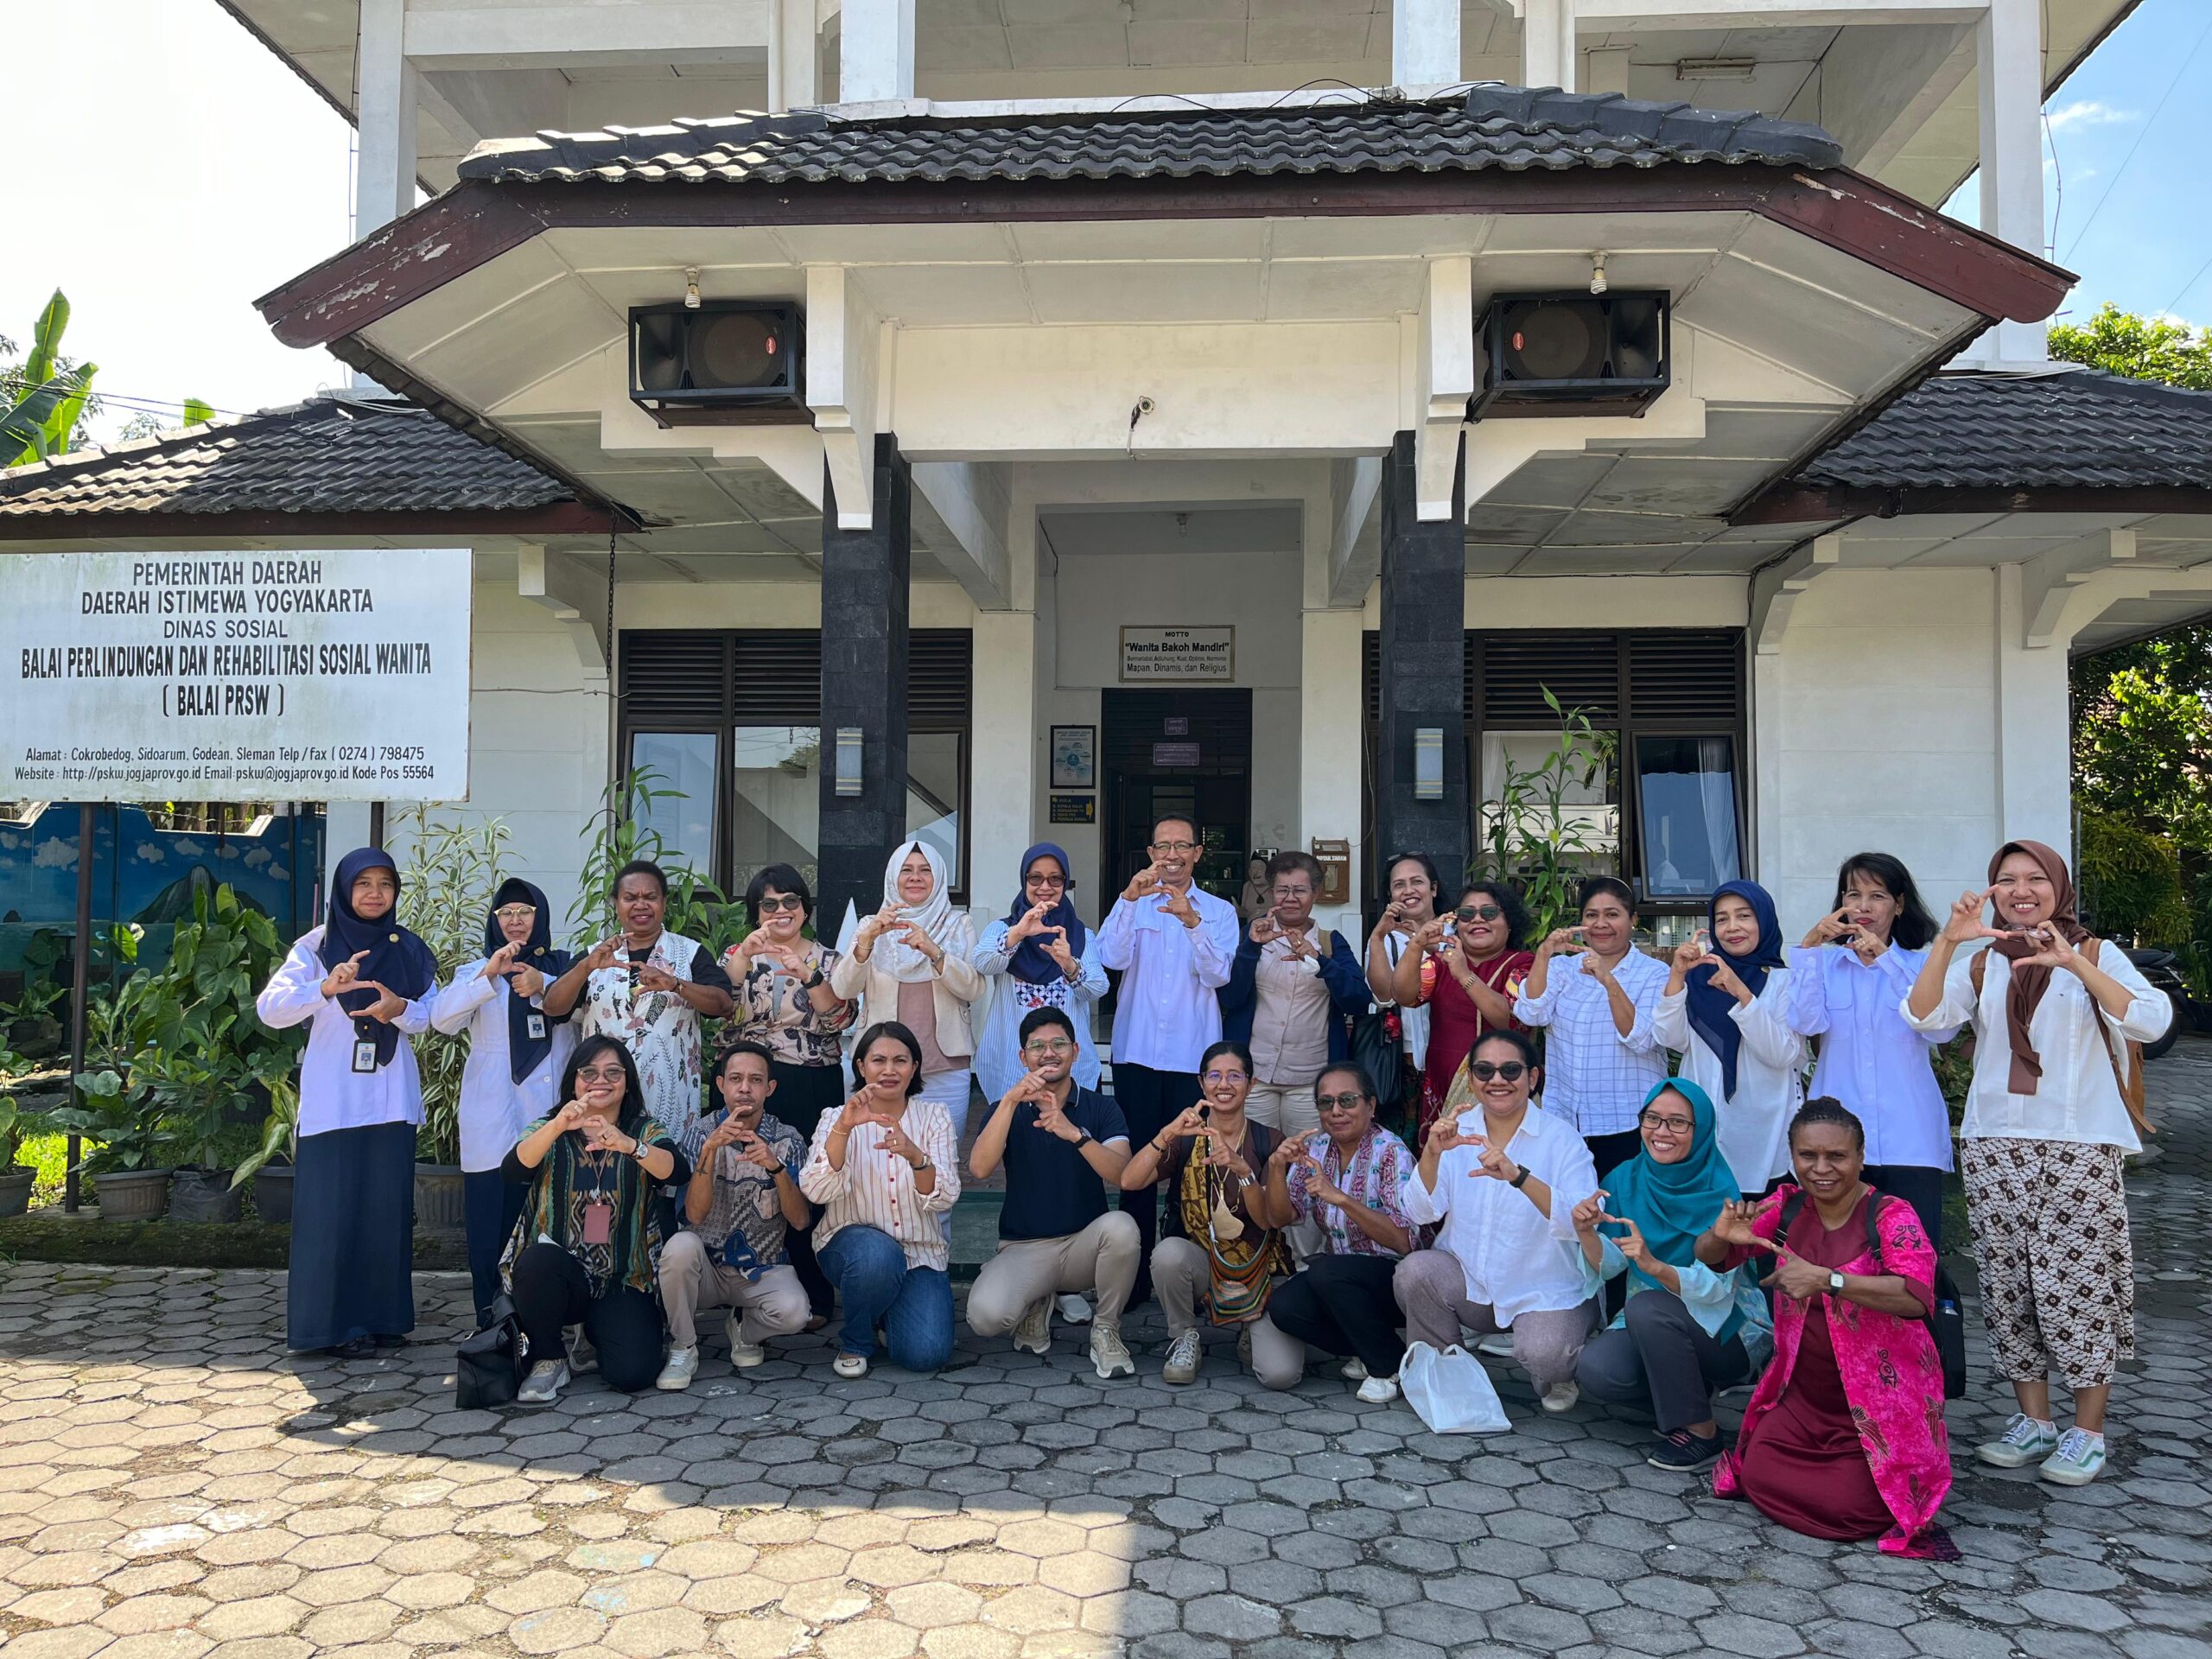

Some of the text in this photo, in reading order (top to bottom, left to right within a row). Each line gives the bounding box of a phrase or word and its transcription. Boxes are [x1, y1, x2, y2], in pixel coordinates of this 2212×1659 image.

[134, 561, 321, 585] PEMERINTAH DAERAH
[82, 589, 372, 614] DAERAH ISTIMEWA YOGYAKARTA
[164, 620, 288, 638] DINAS SOSIAL
[1162, 643, 1189, 652] Bakoh
[22, 643, 430, 678] BALAI PERLINDUNGAN DAN REHABILITASI SOSIAL WANITA
[1200, 664, 1226, 673] Religius
[178, 686, 219, 715] BALAI
[226, 685, 270, 715] PRSW
[236, 747, 275, 760] Sleman
[339, 746, 367, 760] 0274
[379, 746, 424, 760] 798475
[352, 765, 378, 779] Kode
[380, 766, 399, 779] Pos
[403, 765, 435, 779] 55564
